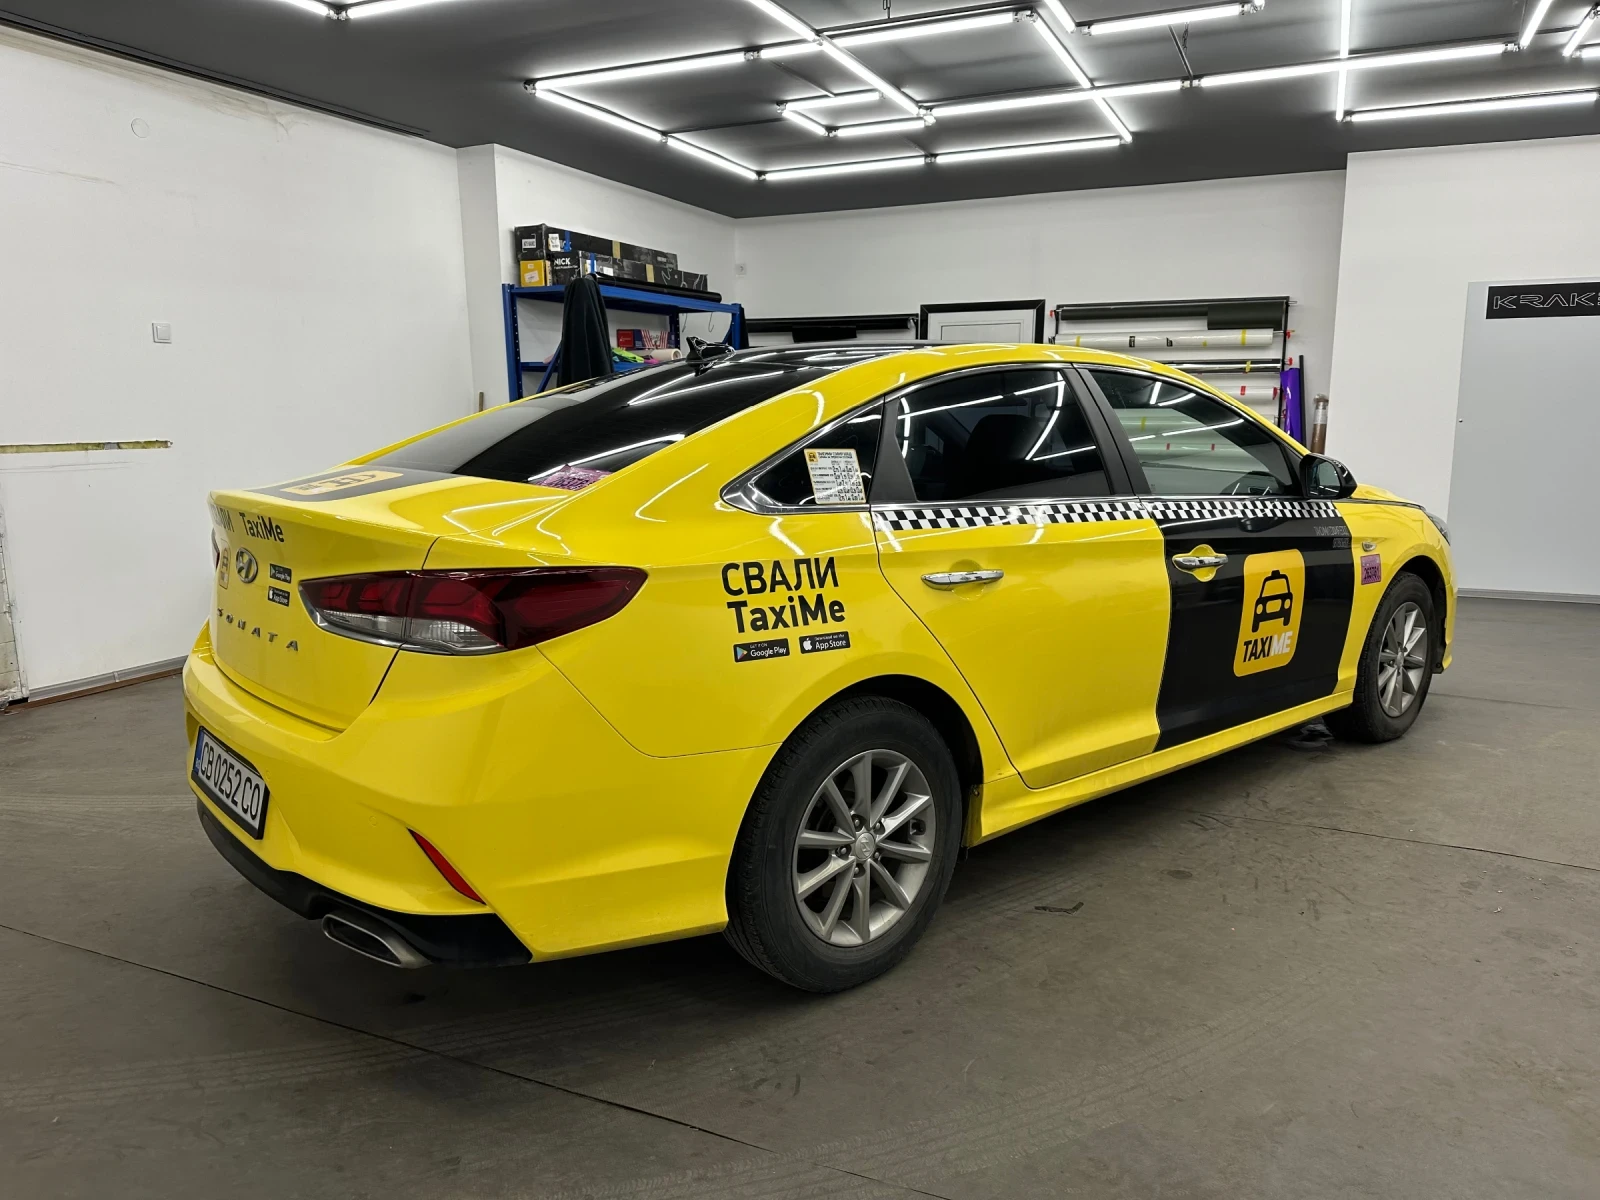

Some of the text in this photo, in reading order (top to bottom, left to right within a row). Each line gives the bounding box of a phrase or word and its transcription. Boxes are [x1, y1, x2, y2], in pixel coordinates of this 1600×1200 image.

[553, 257, 571, 266] NICK
[1493, 292, 1600, 309] KRAK
[239, 512, 285, 543] TaxiMe
[721, 557, 839, 596] СВАЛИ
[726, 593, 845, 633] TaxiMe
[217, 607, 299, 651] SONATA
[750, 646, 787, 657] Google Play
[815, 640, 846, 650] App Store
[1242, 631, 1292, 663] TAXIME
